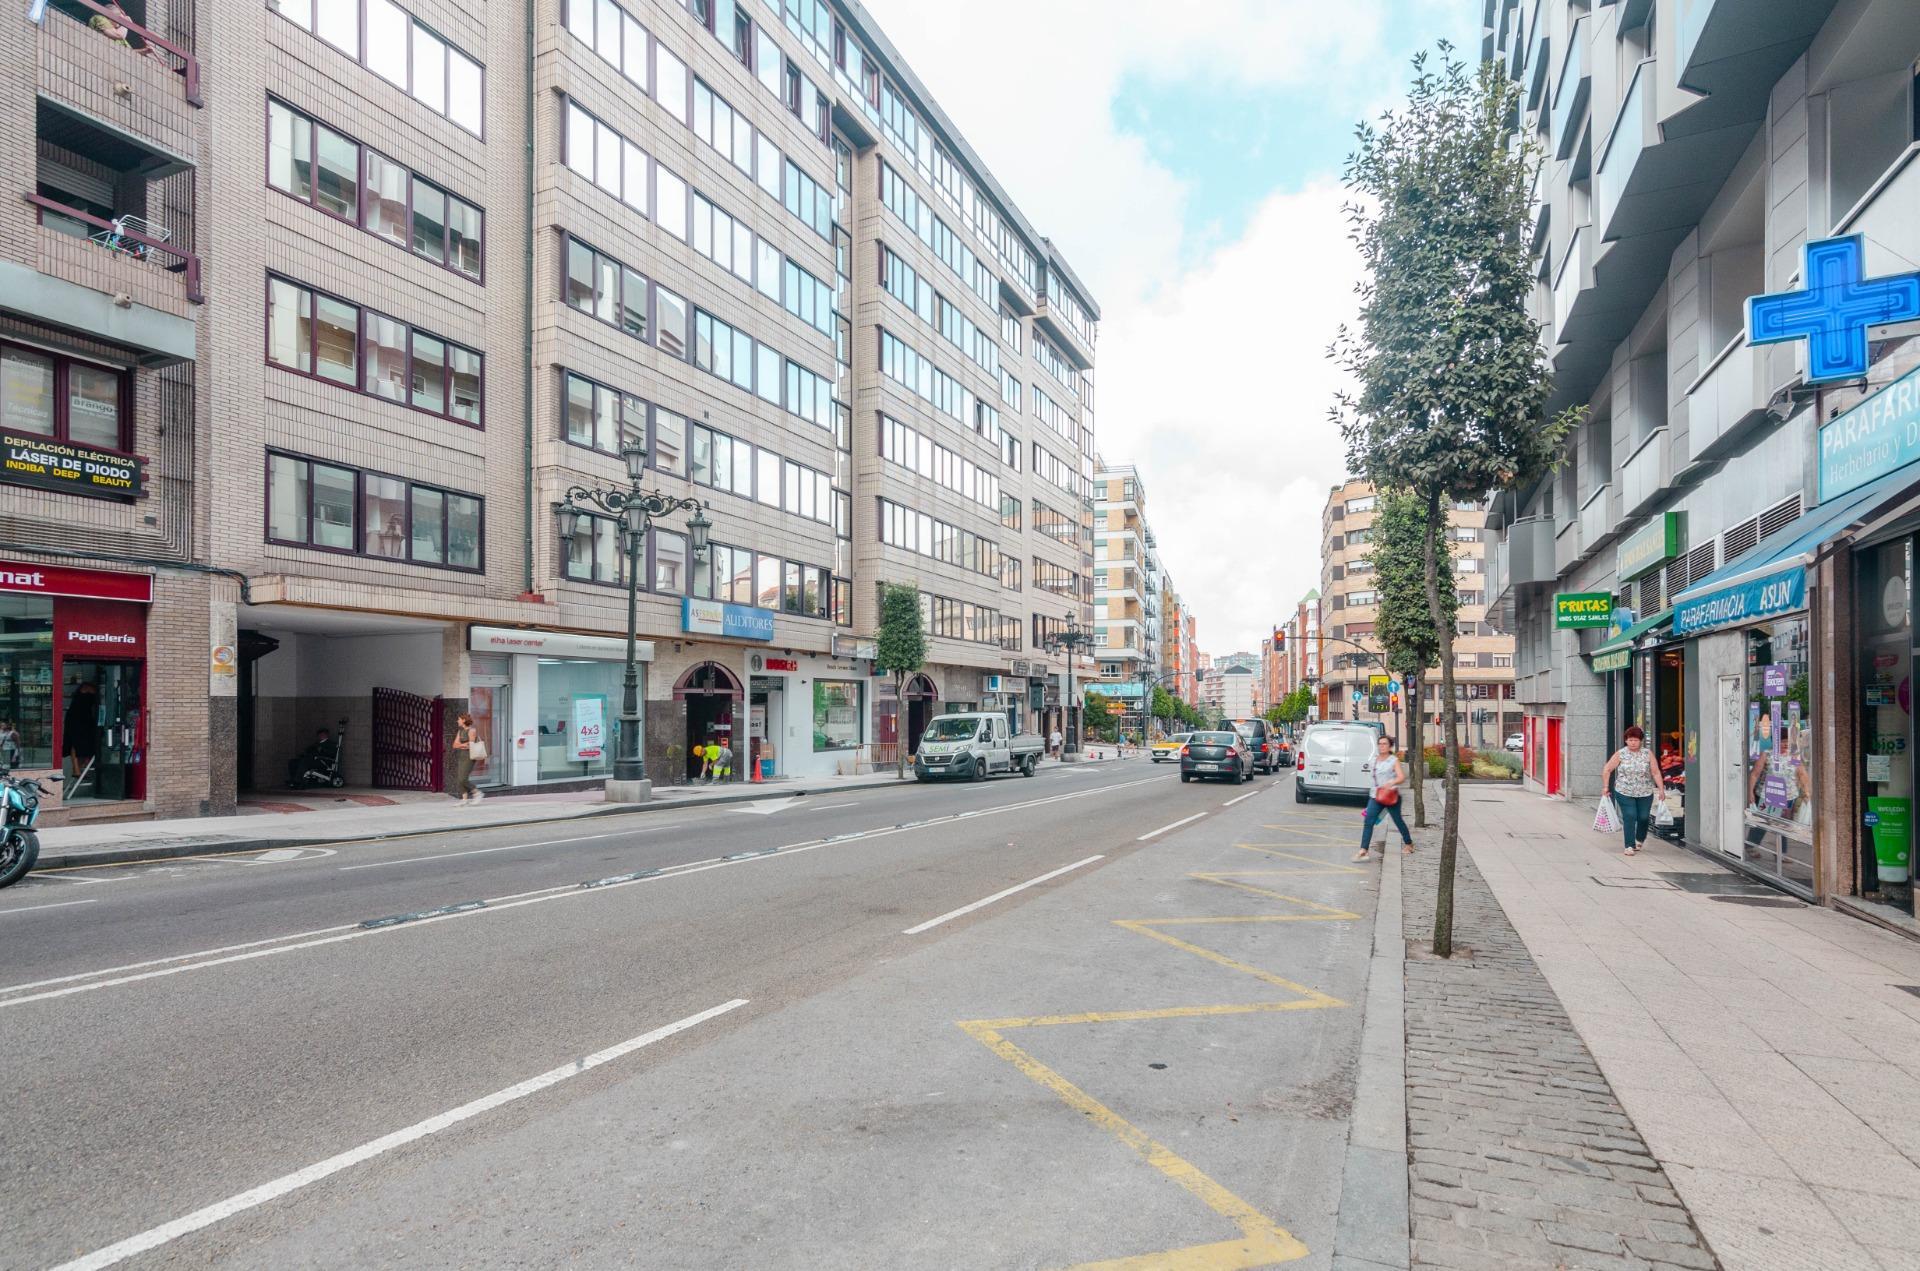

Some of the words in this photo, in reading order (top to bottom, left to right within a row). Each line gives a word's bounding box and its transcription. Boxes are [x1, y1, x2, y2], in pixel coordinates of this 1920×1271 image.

[1823, 375, 1920, 458] PARAFAR
[4, 436, 75, 457] DEPILACIÓN
[77, 449, 136, 468] ELÉCTRICA
[11, 448, 58, 467] LÁSER
[62, 458, 82, 471] DE
[85, 463, 130, 479] DIODO
[1830, 441, 1889, 484] Herbolario
[1893, 435, 1901, 463] y
[6, 460, 46, 473] INDIBA
[53, 468, 80, 479] DEEP
[92, 475, 132, 488] BEAUTY
[1558, 600, 1609, 612] FRUTAS
[1680, 593, 1745, 628] PARAFARMACIA
[1760, 580, 1791, 610] ASUN
[724, 614, 773, 631] AUDITORES
[68, 631, 136, 643] Papelería
[506, 637, 521, 646] laser
[523, 639, 544, 647] center
[580, 724, 600, 736] 4x3
